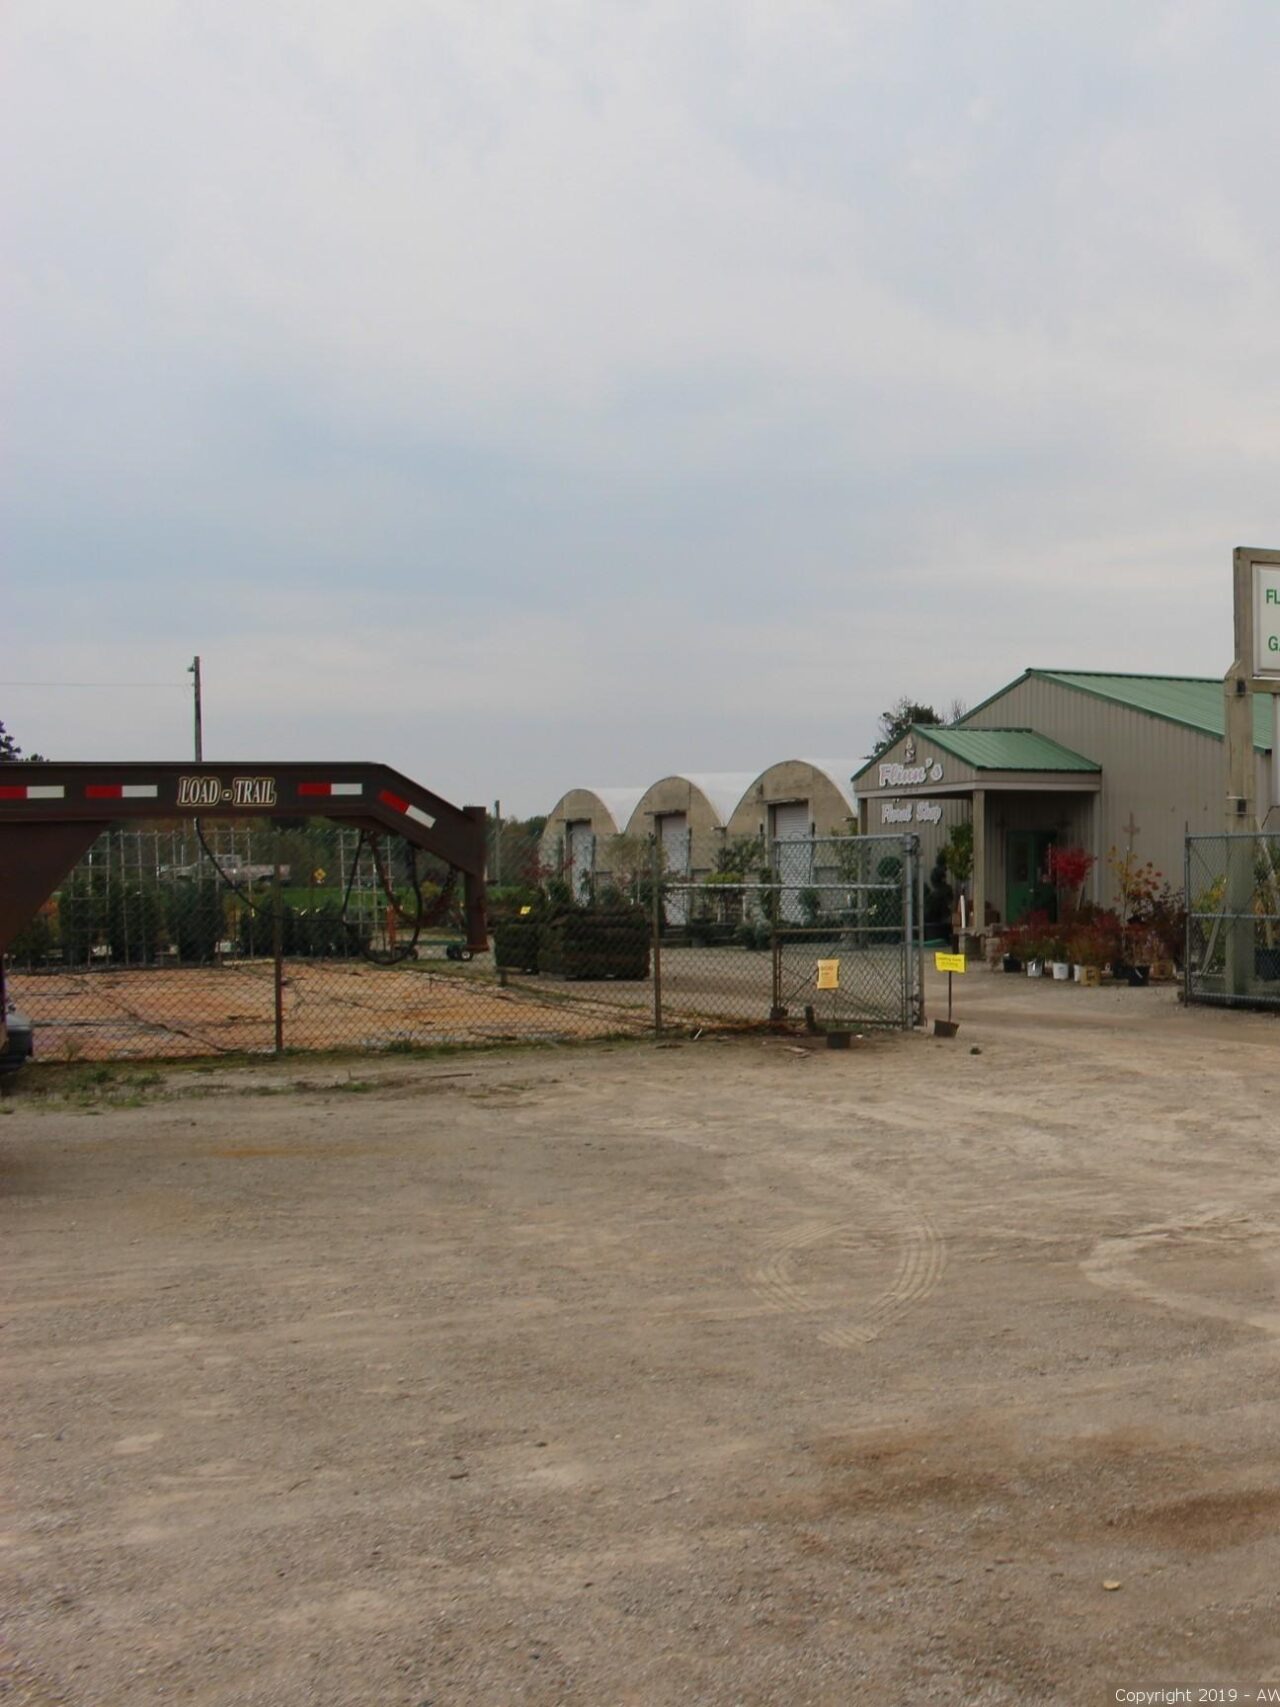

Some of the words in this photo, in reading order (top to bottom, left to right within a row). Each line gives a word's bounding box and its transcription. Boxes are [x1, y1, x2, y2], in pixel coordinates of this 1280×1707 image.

[879, 758, 943, 788] Flinn's
[178, 777, 221, 805] LOAD
[233, 777, 276, 806] TRAIL
